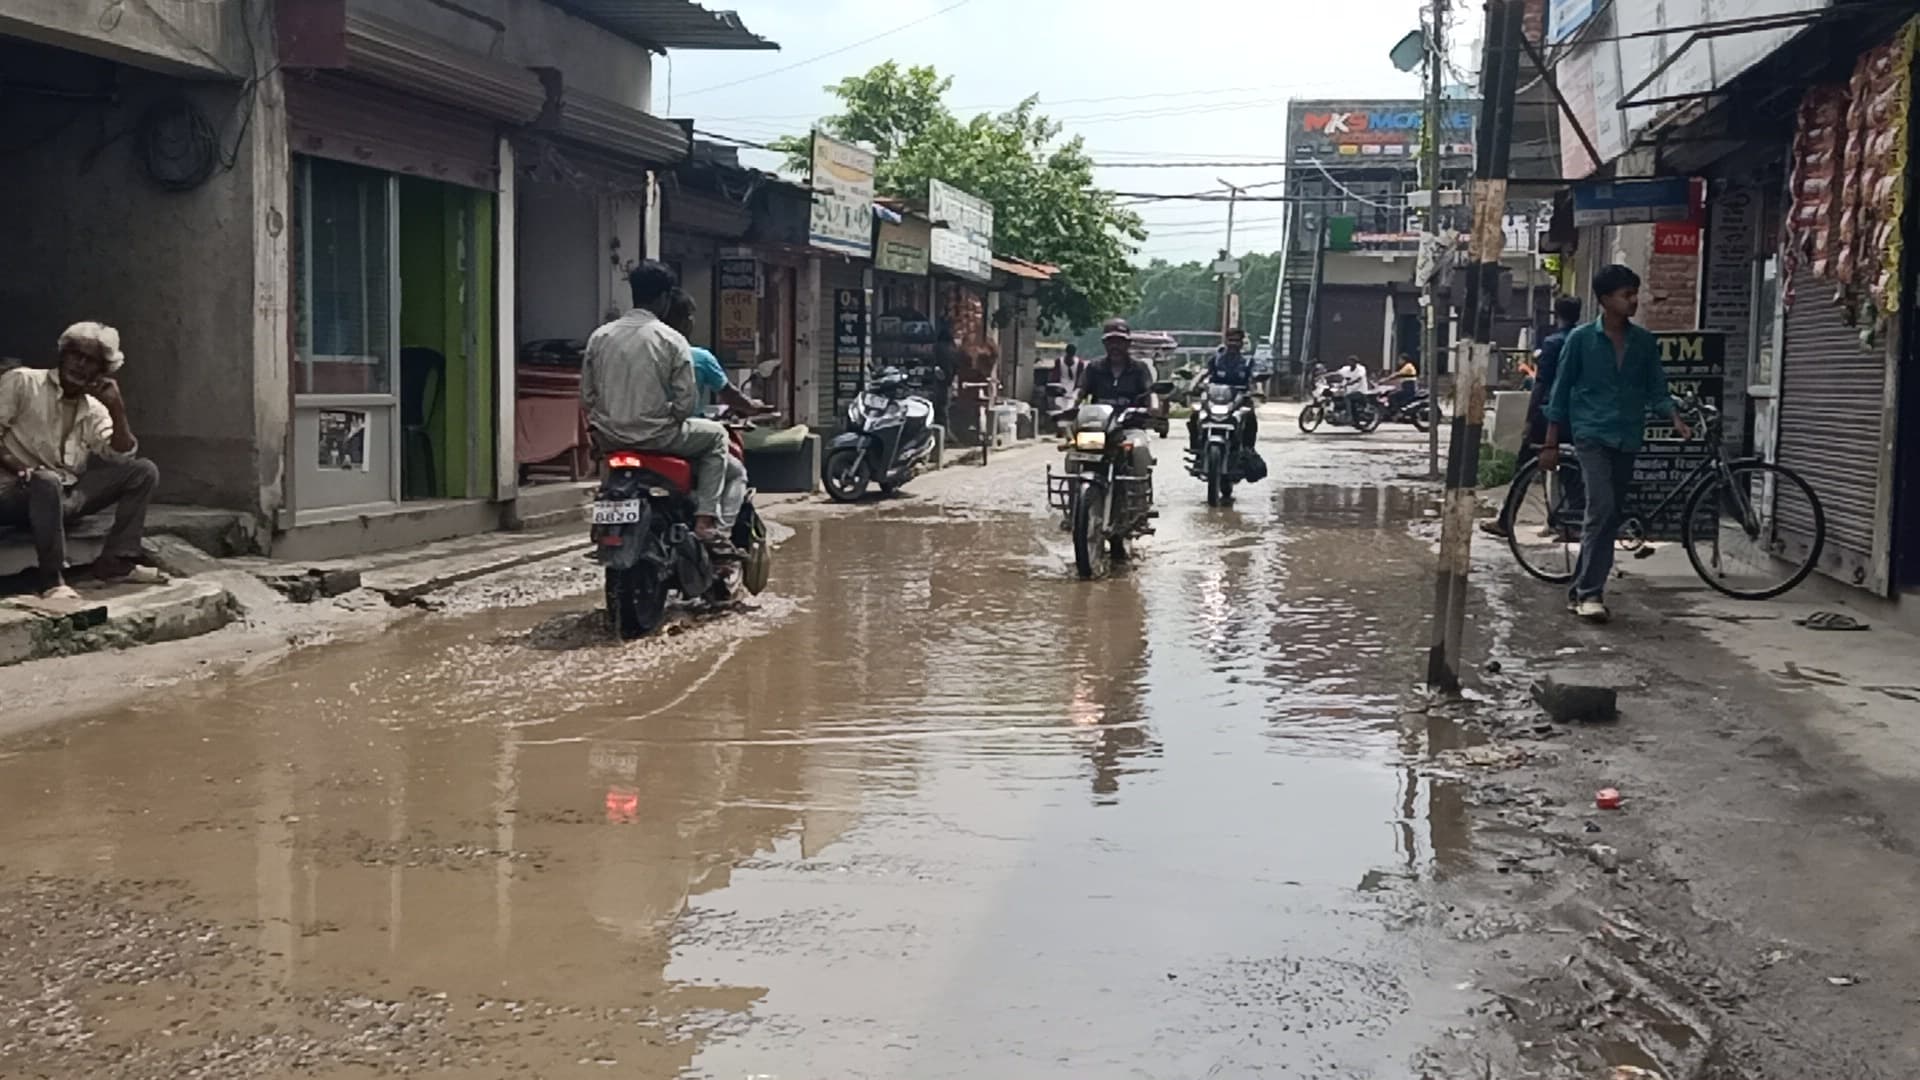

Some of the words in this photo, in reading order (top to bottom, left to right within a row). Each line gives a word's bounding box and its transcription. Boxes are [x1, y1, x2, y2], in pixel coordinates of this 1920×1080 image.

[1304, 112, 1368, 134] MKS
[1662, 234, 1696, 247] ATM
[1656, 337, 1704, 362] TM
[1667, 380, 1702, 395] NEY
